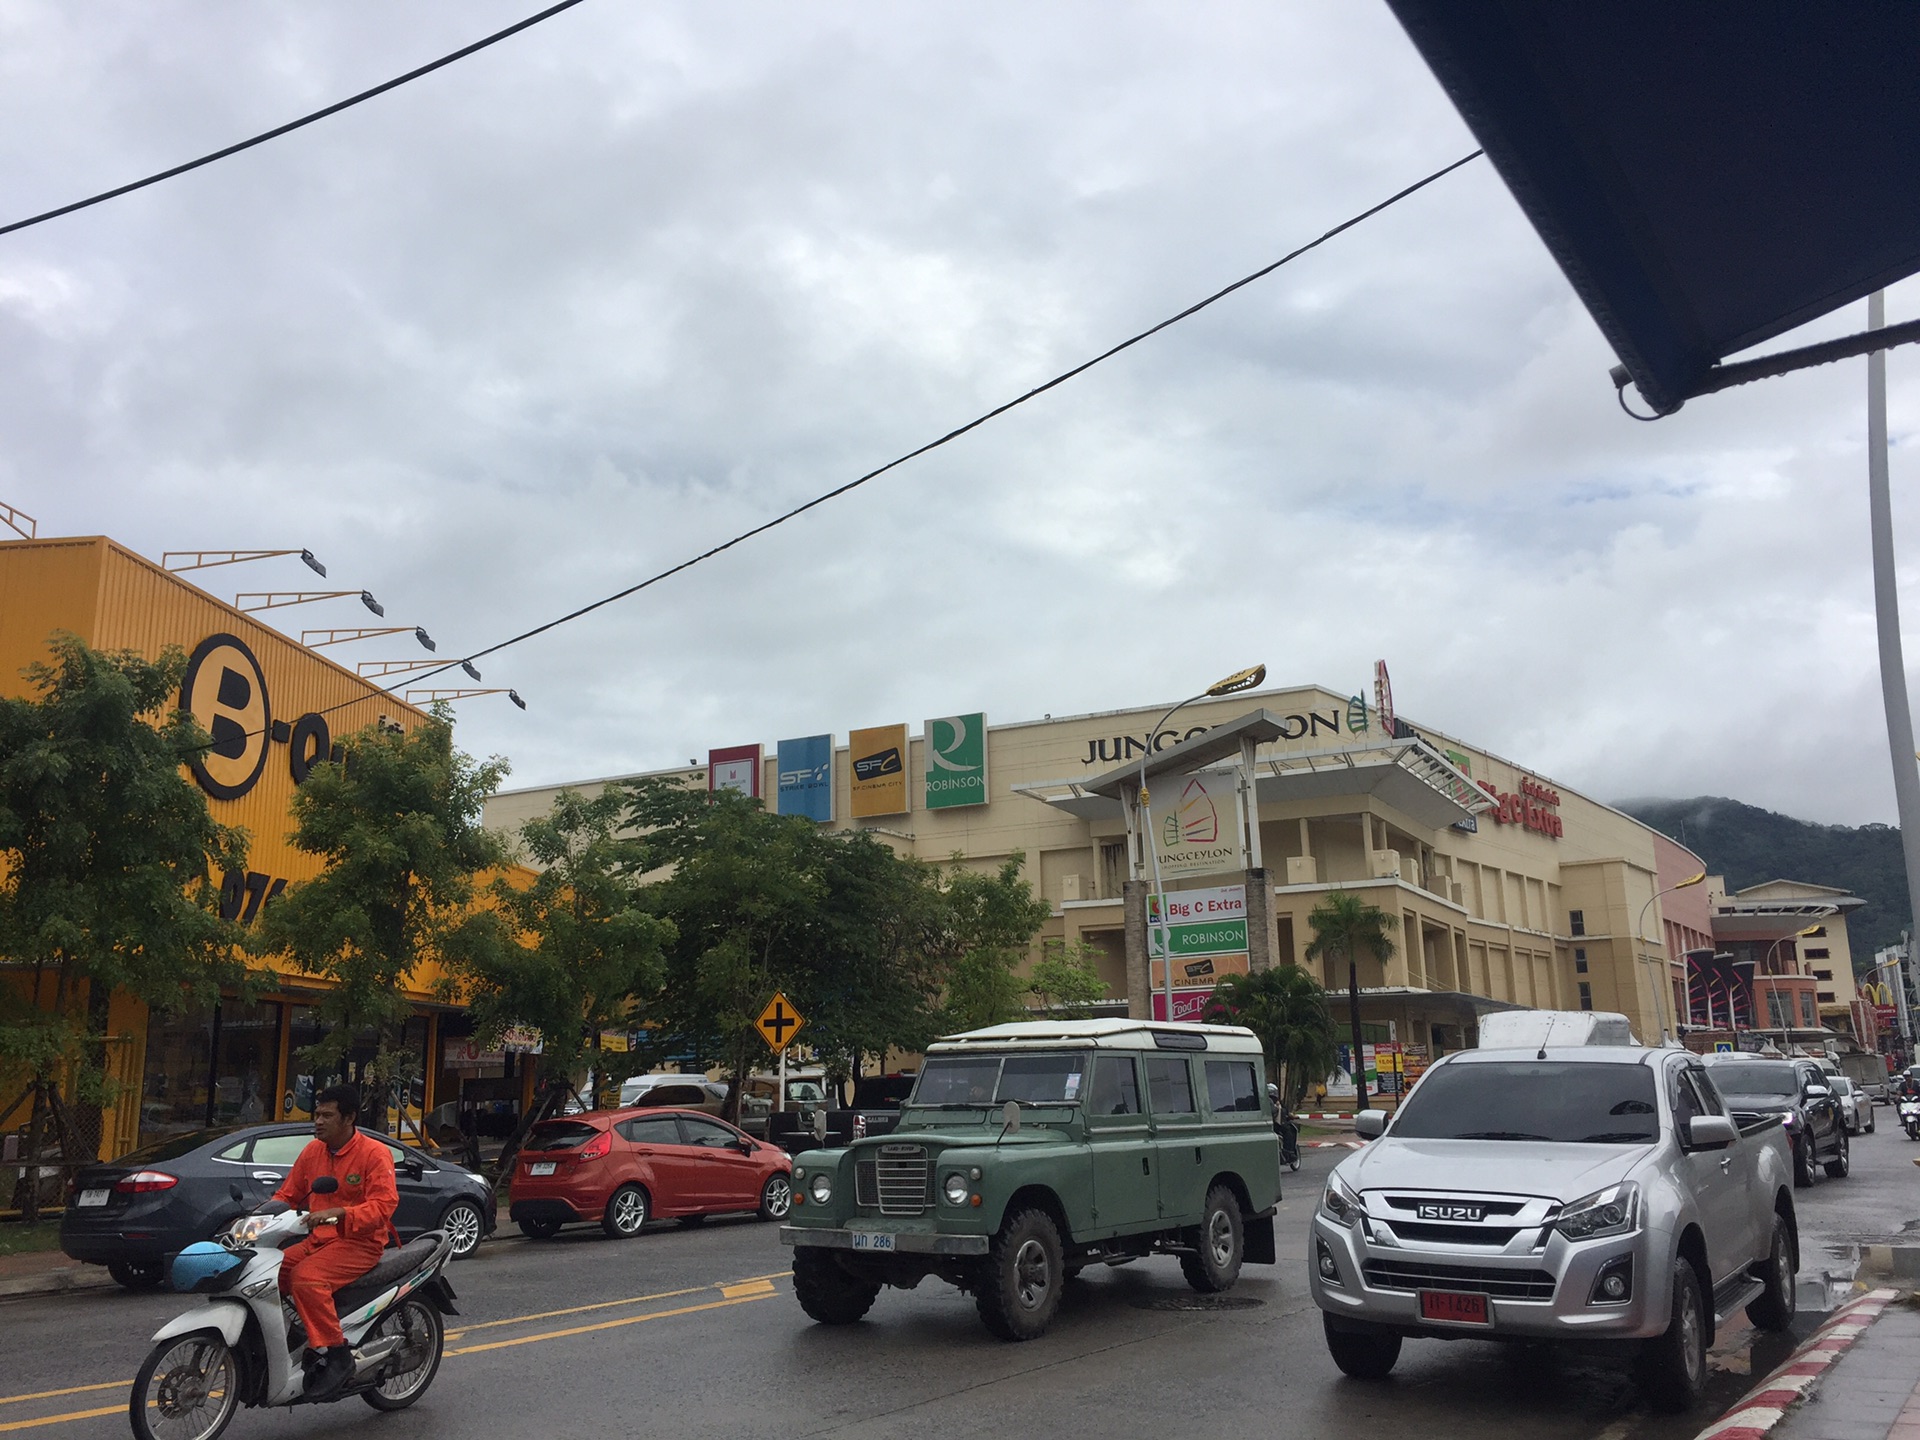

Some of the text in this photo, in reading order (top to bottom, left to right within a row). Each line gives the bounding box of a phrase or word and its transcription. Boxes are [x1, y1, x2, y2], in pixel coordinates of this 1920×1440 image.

[1081, 709, 1340, 764] JUNGON
[780, 769, 812, 785] SF
[926, 776, 984, 792] ROBINSON
[1510, 794, 1523, 823] C
[1525, 799, 1563, 838] Extra
[1158, 847, 1233, 864] UNGCEYLON
[1169, 899, 1242, 917] Big C Extra
[1182, 930, 1244, 945] ROBINSON
[1174, 977, 1214, 986] CINEMA
[1420, 1205, 1480, 1221] ISUZU
[873, 1235, 891, 1248] 286
